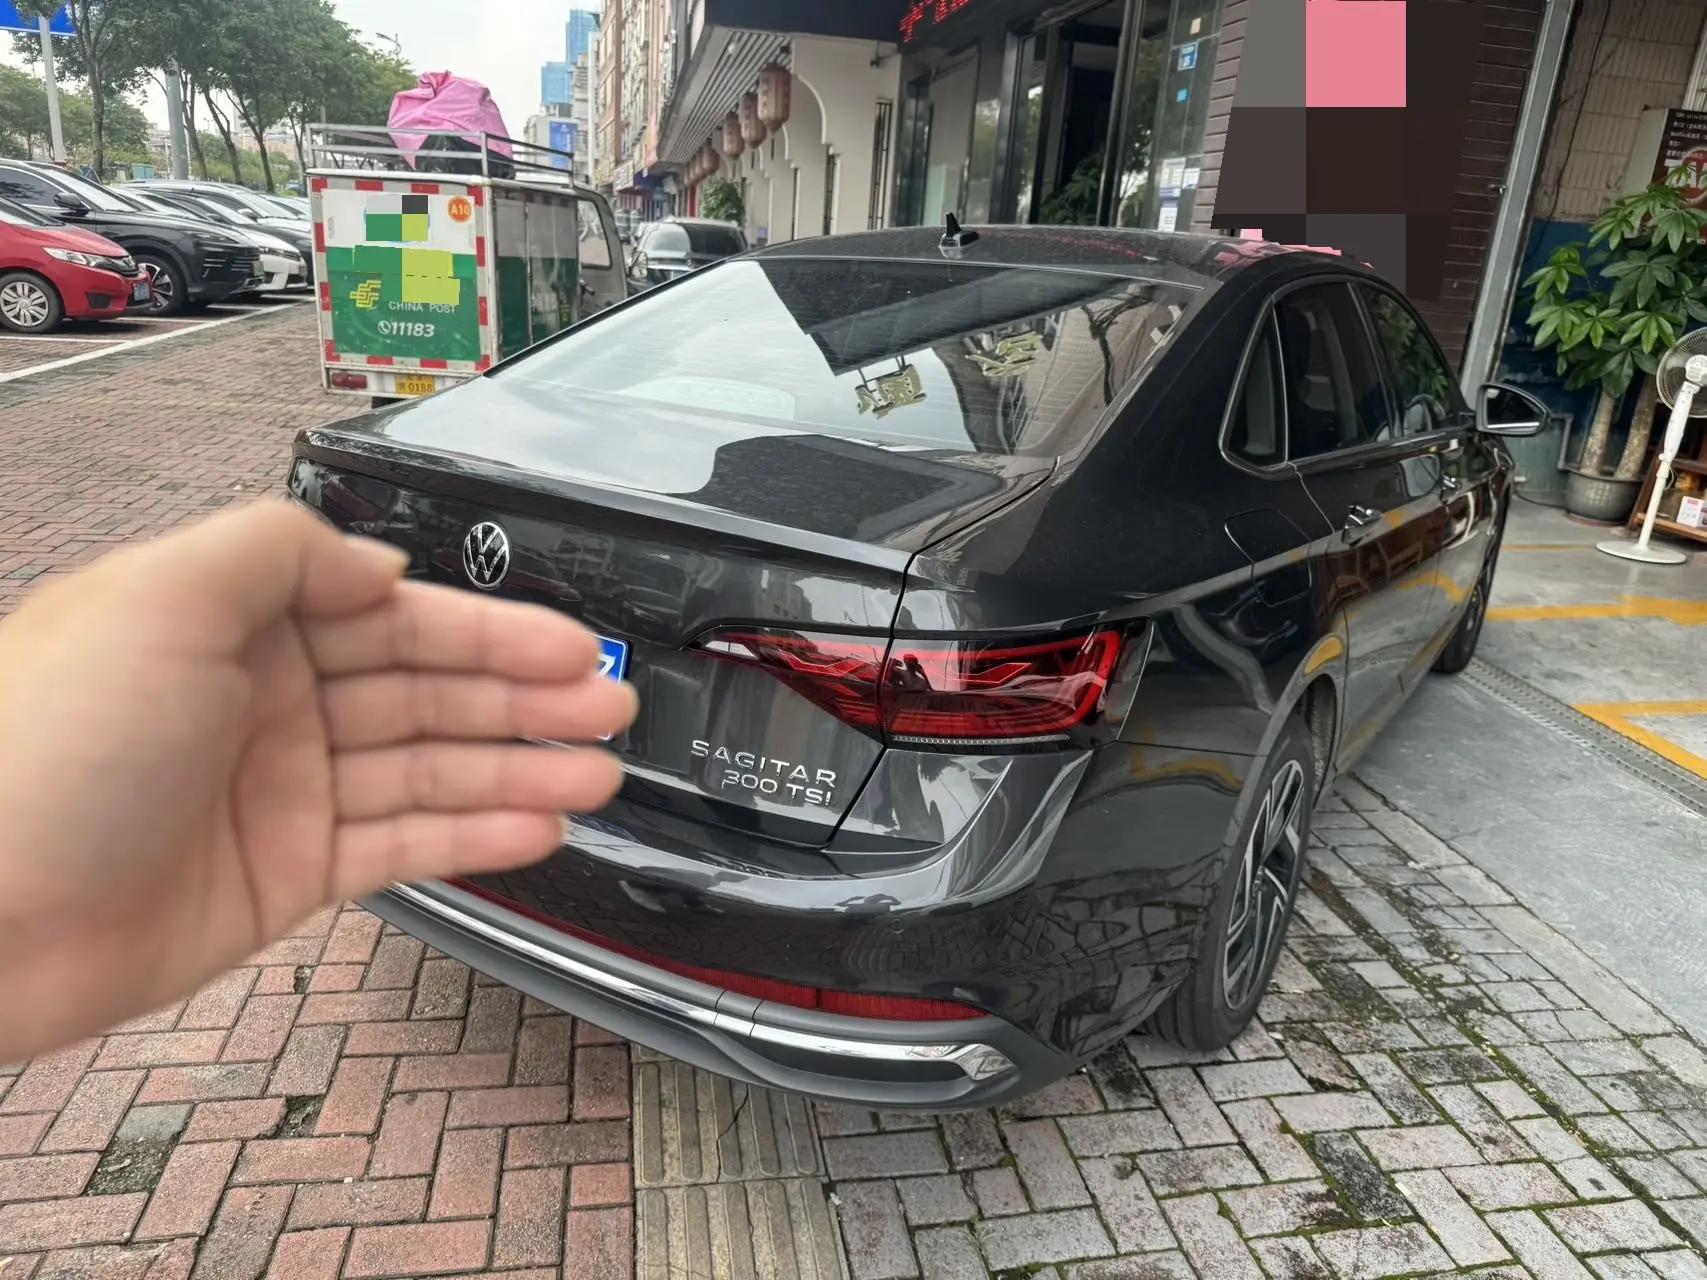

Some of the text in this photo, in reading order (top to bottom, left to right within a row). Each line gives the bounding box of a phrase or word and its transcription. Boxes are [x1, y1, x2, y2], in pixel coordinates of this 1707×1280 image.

[389, 301, 457, 313] CHINA POST
[391, 322, 435, 338] 11183
[691, 740, 836, 788] SAGITAR
[721, 770, 832, 806] 300 TSI
